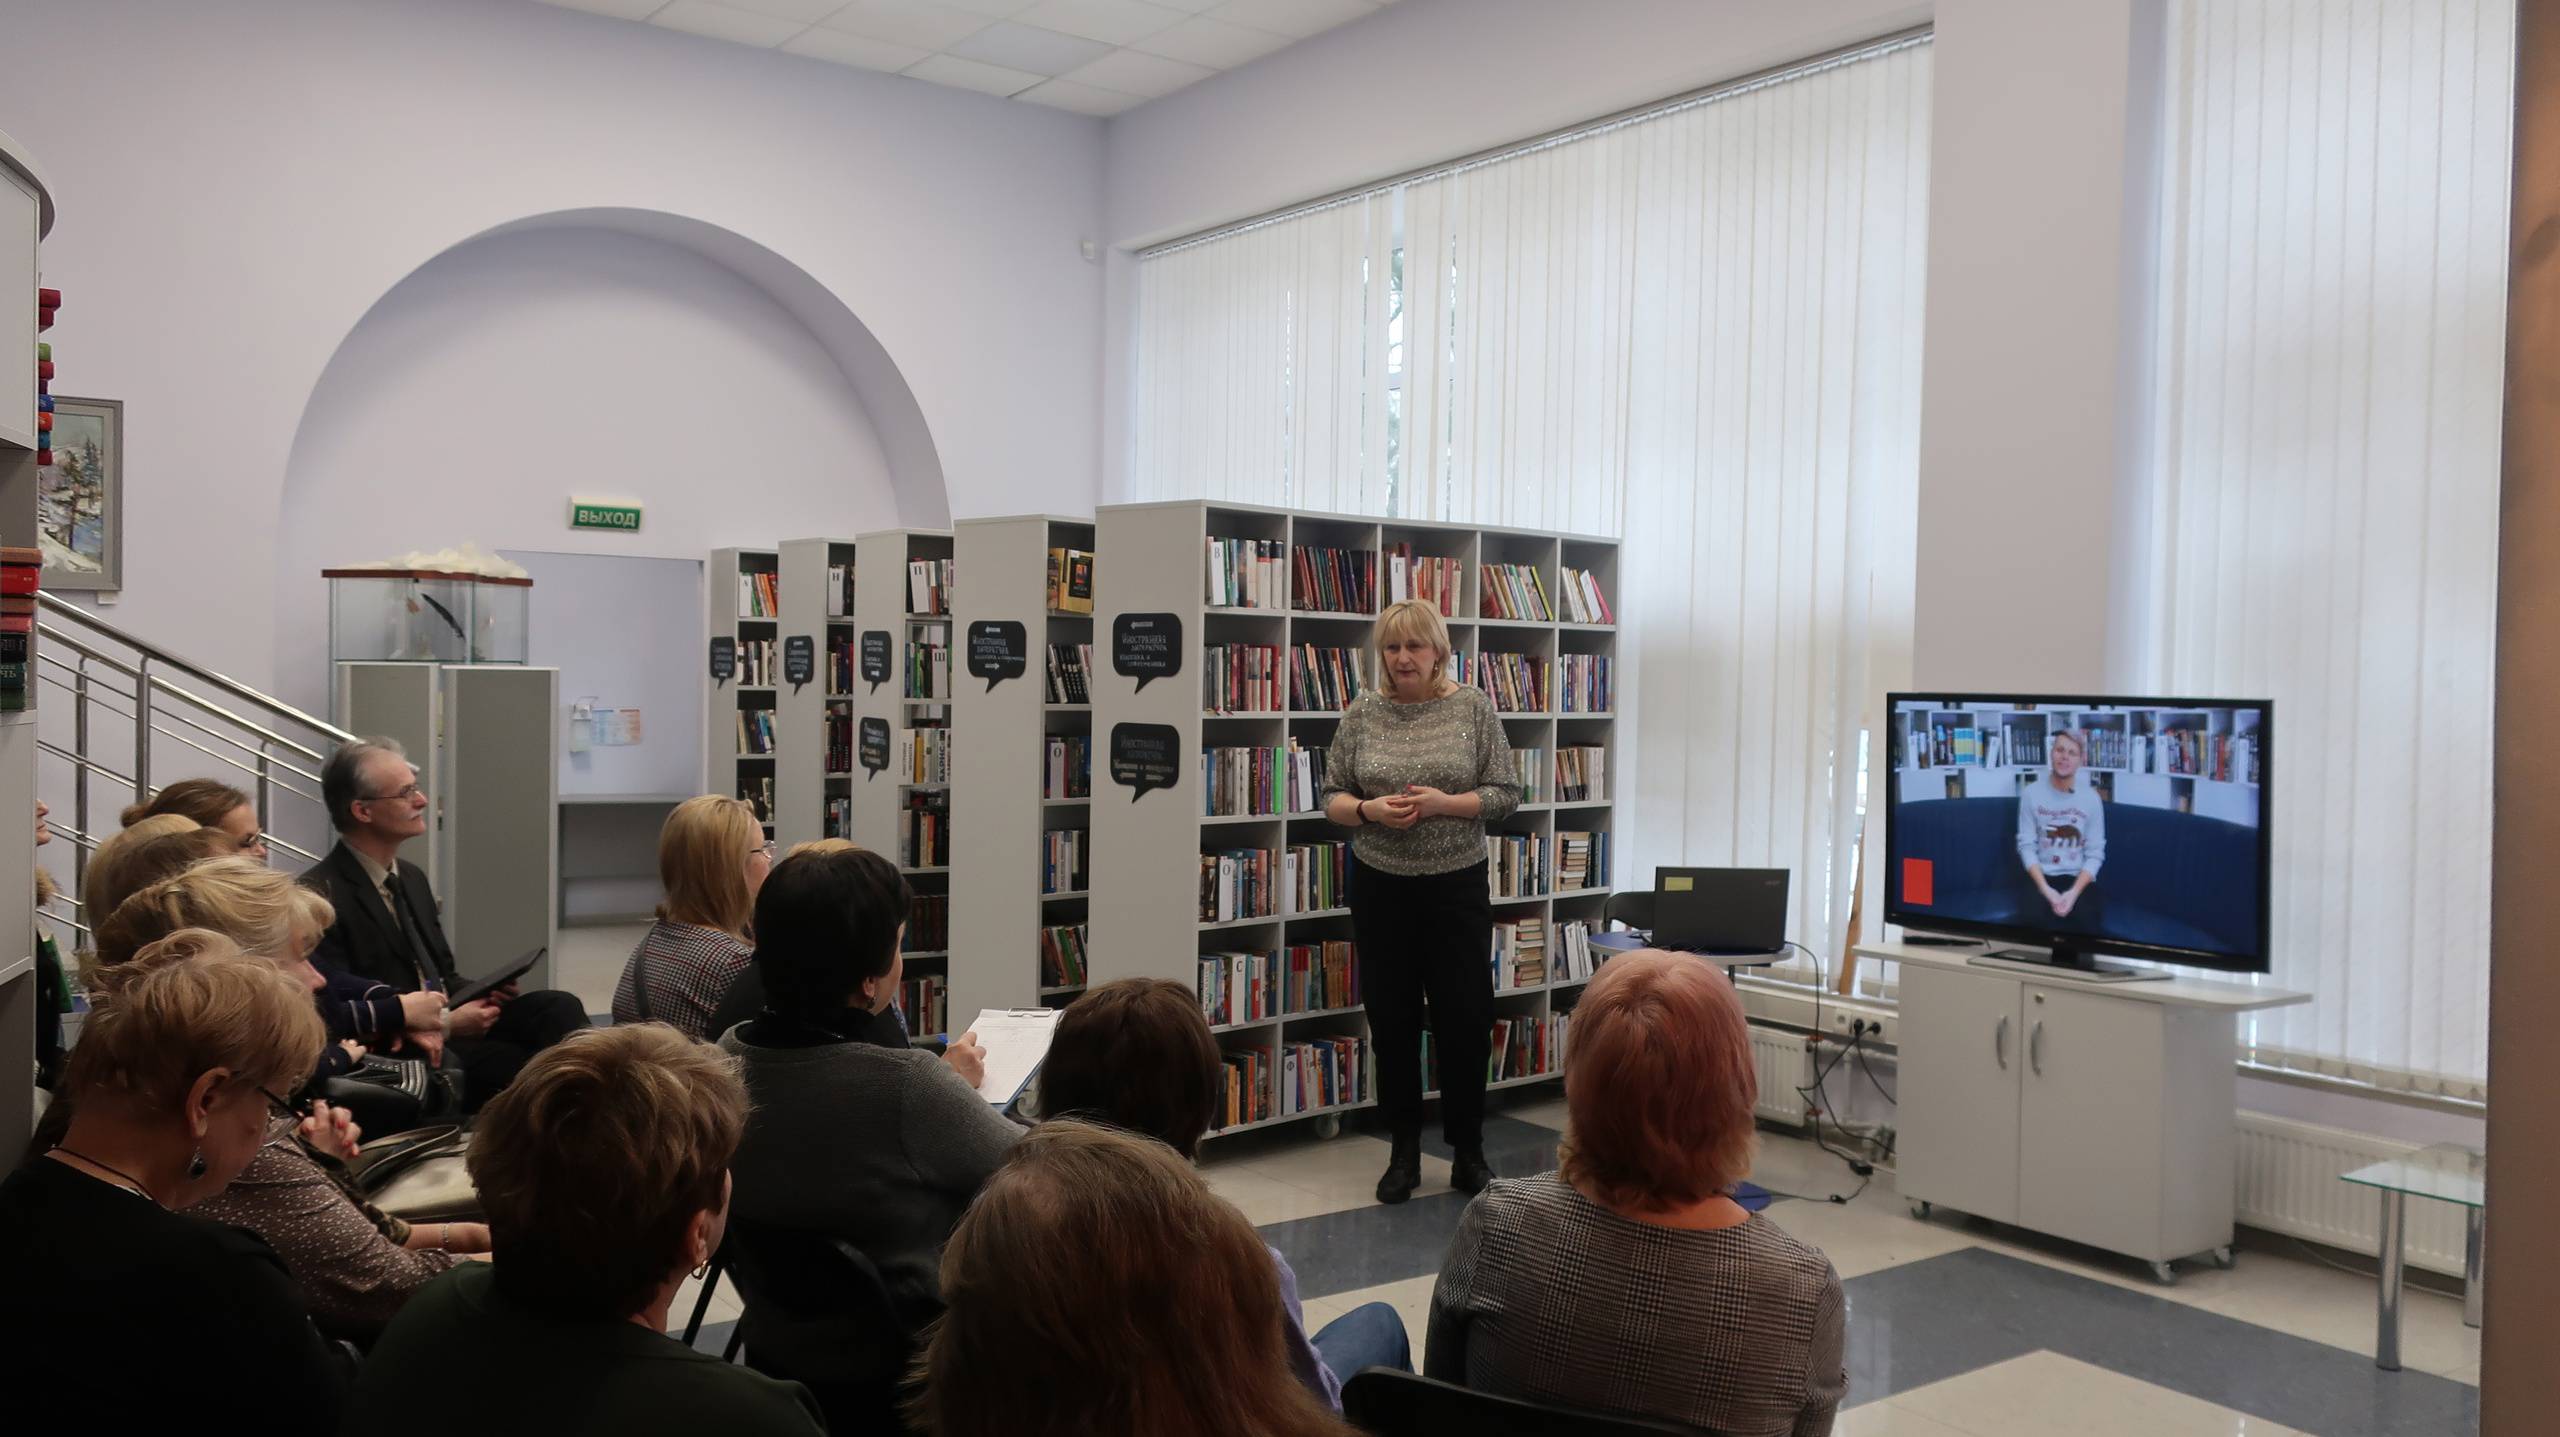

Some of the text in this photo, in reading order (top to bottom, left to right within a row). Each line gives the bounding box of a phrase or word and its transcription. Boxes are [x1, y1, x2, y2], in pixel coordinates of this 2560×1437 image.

[579, 510, 636, 528] ВЫХОД
[914, 565, 922, 575] П
[832, 572, 840, 581] Н
[934, 652, 946, 662] Ш
[1299, 757, 1308, 768] М
[1287, 858, 1294, 870] П
[1222, 864, 1231, 876] О
[1236, 960, 1243, 973] С
[1286, 1061, 1295, 1071] Ф
